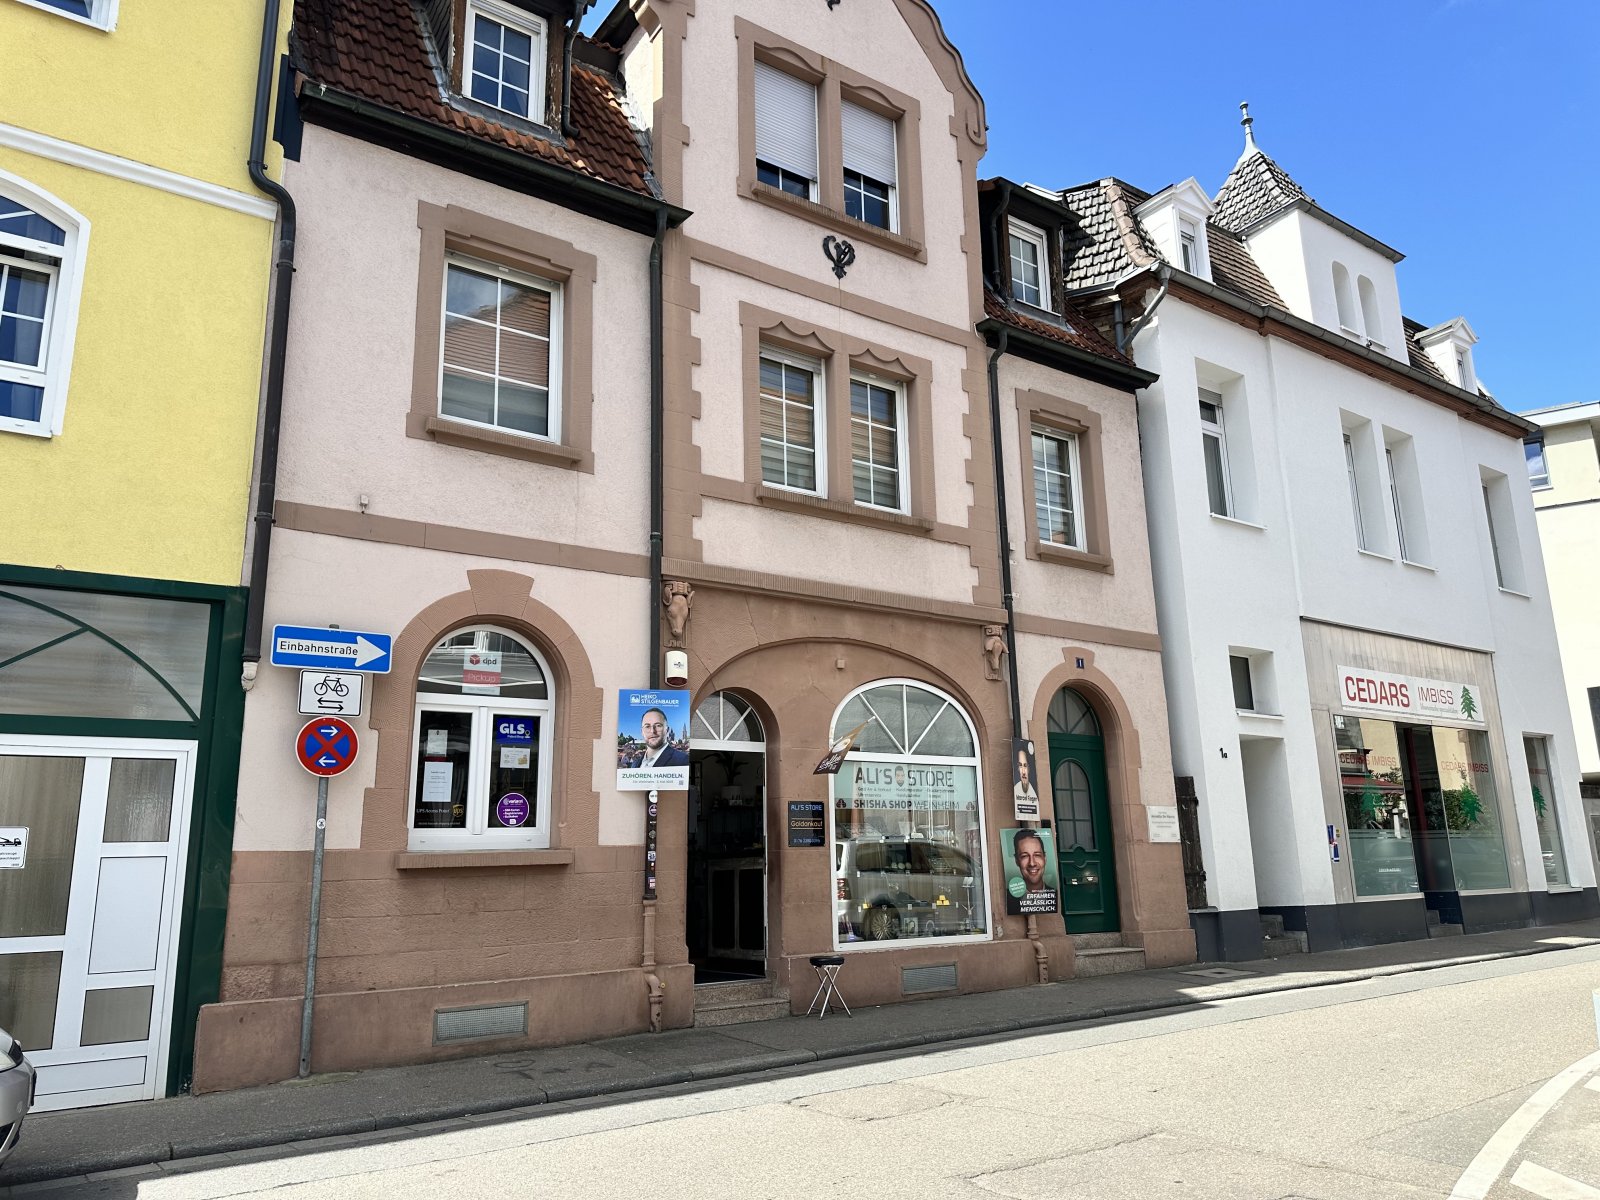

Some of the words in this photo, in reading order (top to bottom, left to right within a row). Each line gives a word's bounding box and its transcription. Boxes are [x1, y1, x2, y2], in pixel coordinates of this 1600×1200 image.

[280, 640, 359, 656] Einbahnstraße
[482, 657, 497, 665] dpd
[1344, 676, 1410, 708] CEDARS
[1417, 686, 1454, 705] IMBISS
[499, 723, 525, 735] GLS
[1219, 747, 1228, 759] 1a
[1339, 753, 1370, 765] CEDARS
[1371, 755, 1397, 767] IMBISS
[1440, 761, 1466, 771] CEDARS
[1467, 762, 1489, 773] IMBISS
[855, 766, 893, 785] ALI'S
[907, 769, 954, 787] STORE
[853, 799, 888, 809] SHISHA
[888, 800, 913, 809] SHOP
[913, 801, 960, 810] WEINHEIM
[790, 820, 823, 828] Goldankauf
